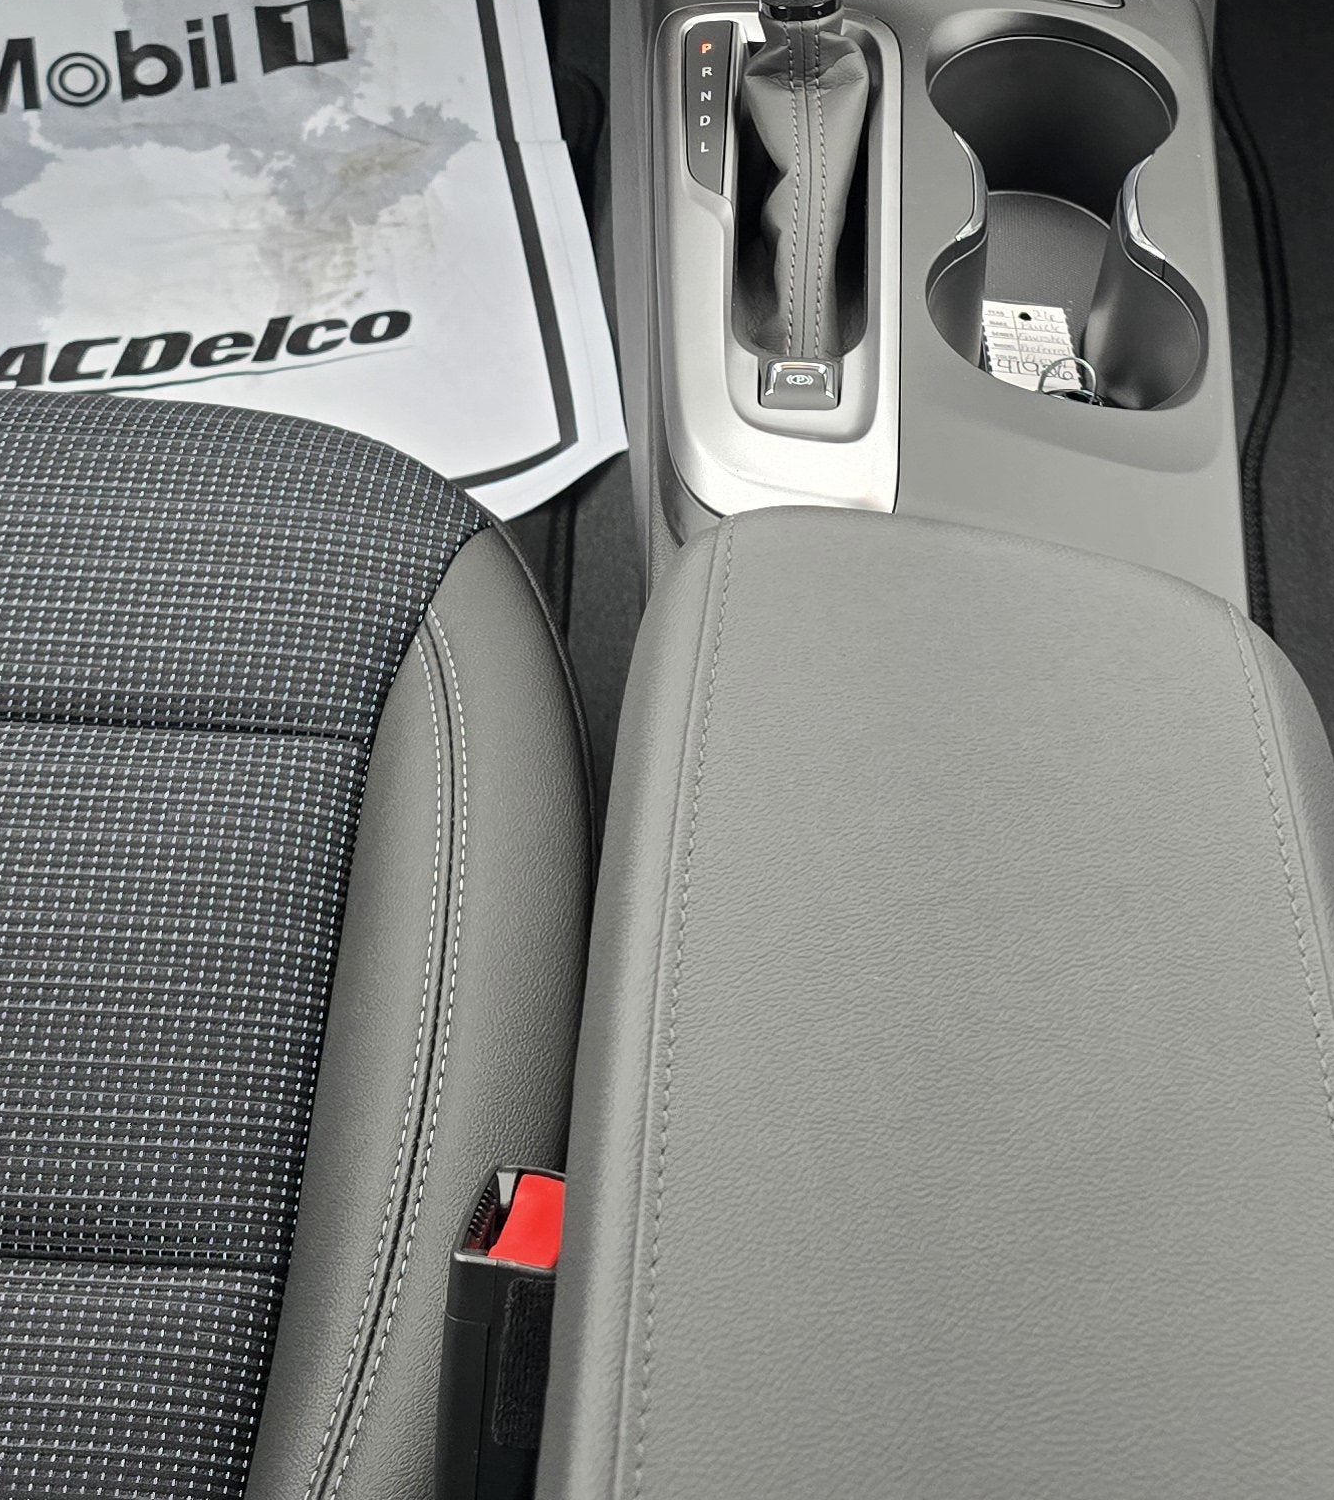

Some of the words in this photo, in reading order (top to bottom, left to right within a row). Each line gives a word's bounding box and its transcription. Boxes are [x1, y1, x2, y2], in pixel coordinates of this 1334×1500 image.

[701, 43, 712, 54] P
[701, 66, 713, 78] R
[701, 90, 712, 102] N
[699, 115, 711, 126] D
[701, 142, 709, 153] L
